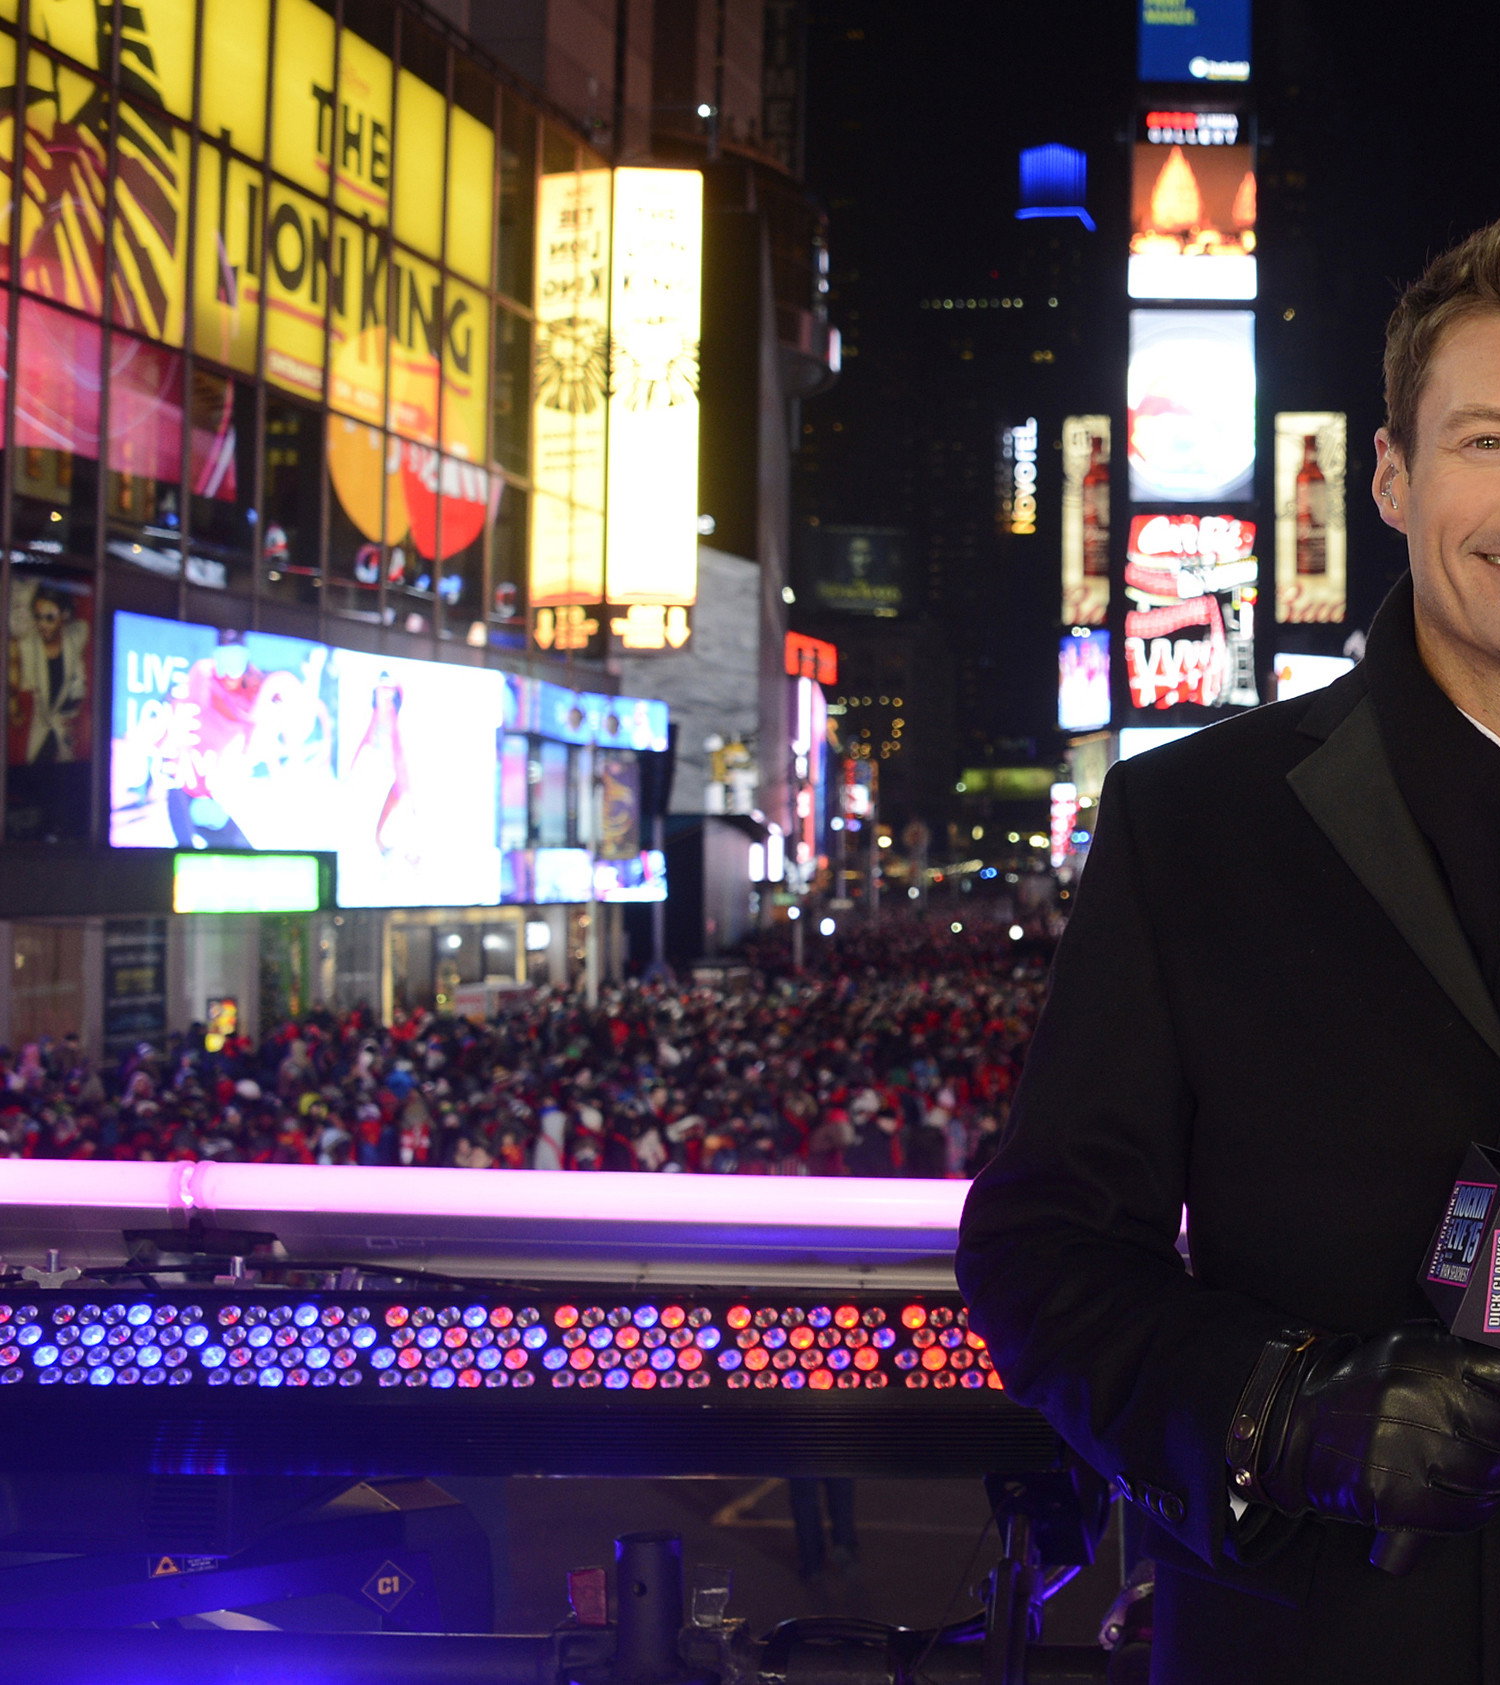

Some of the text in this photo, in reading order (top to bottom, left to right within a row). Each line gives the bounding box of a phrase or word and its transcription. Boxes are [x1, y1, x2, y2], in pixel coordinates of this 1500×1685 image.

[312, 82, 390, 188] THE
[217, 128, 347, 318] LION
[359, 209, 473, 376] KING
[1011, 416, 1038, 534] NOVOTEL
[127, 651, 190, 699] LIVE
[377, 1576, 399, 1595] C1
